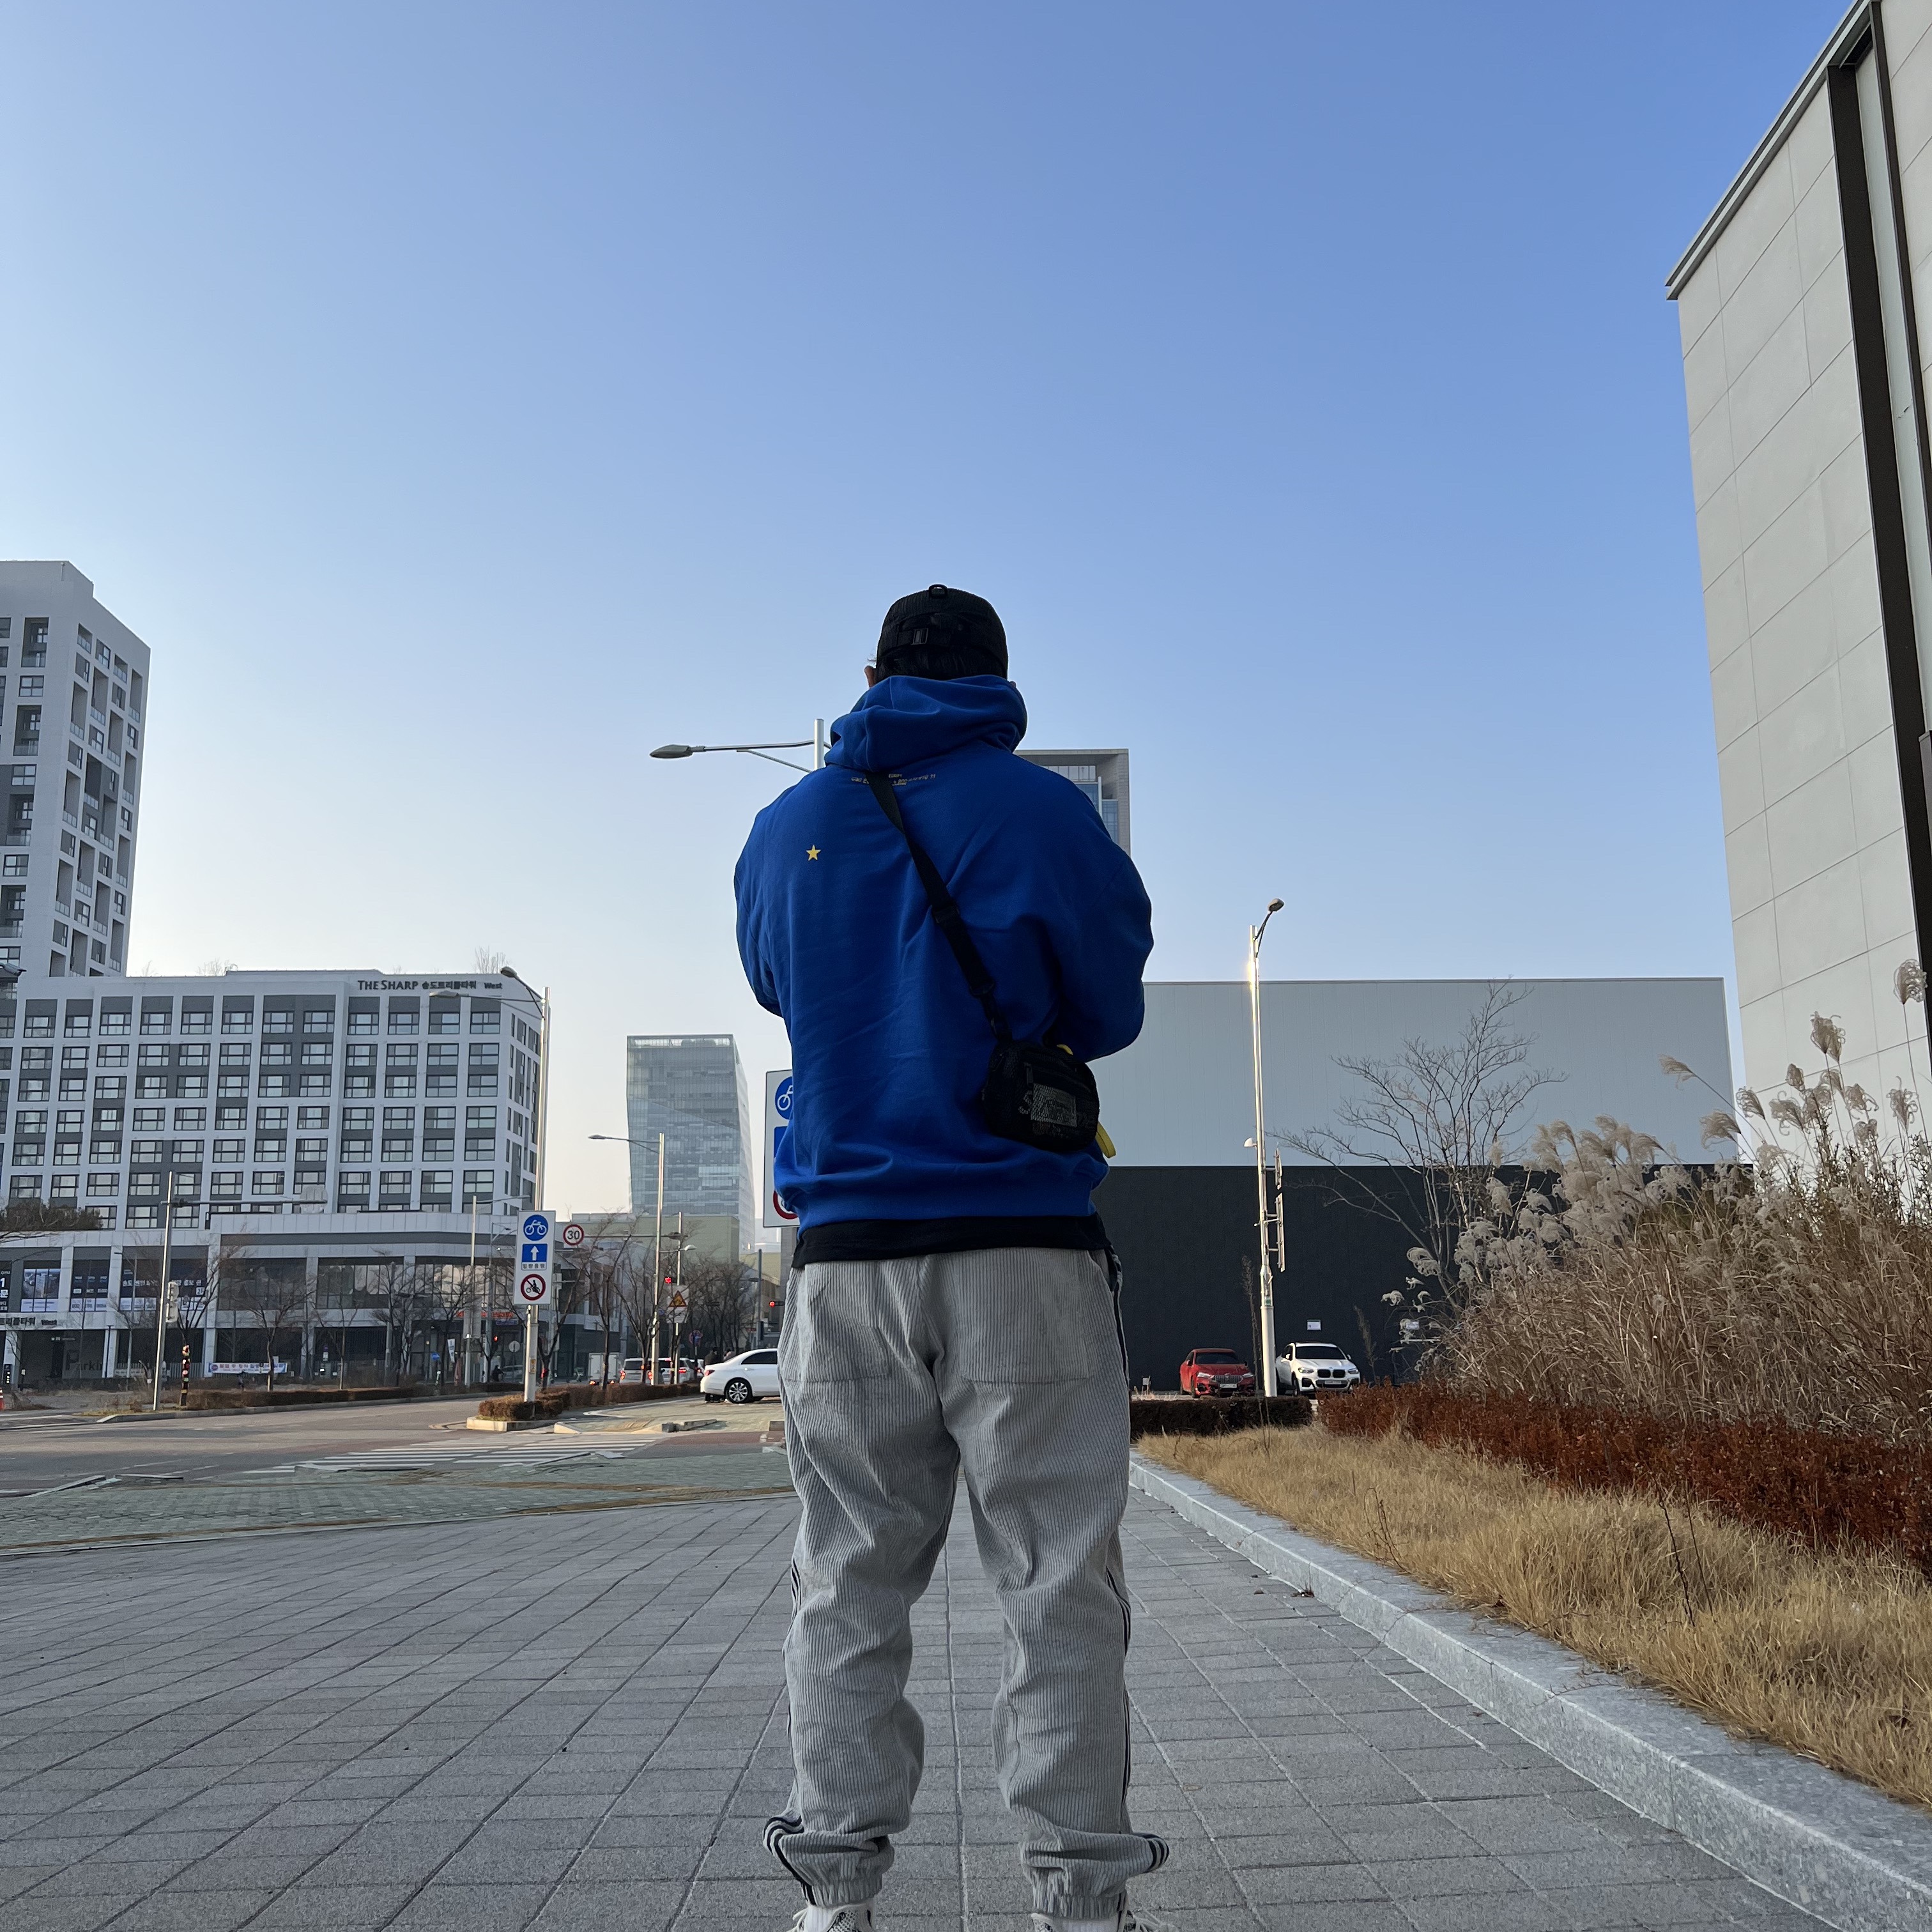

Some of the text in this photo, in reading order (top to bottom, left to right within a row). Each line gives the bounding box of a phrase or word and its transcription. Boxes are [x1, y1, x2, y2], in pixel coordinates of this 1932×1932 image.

[358, 980, 378, 990] THE
[381, 980, 418, 990] SHARP
[567, 1230, 580, 1240] 30
